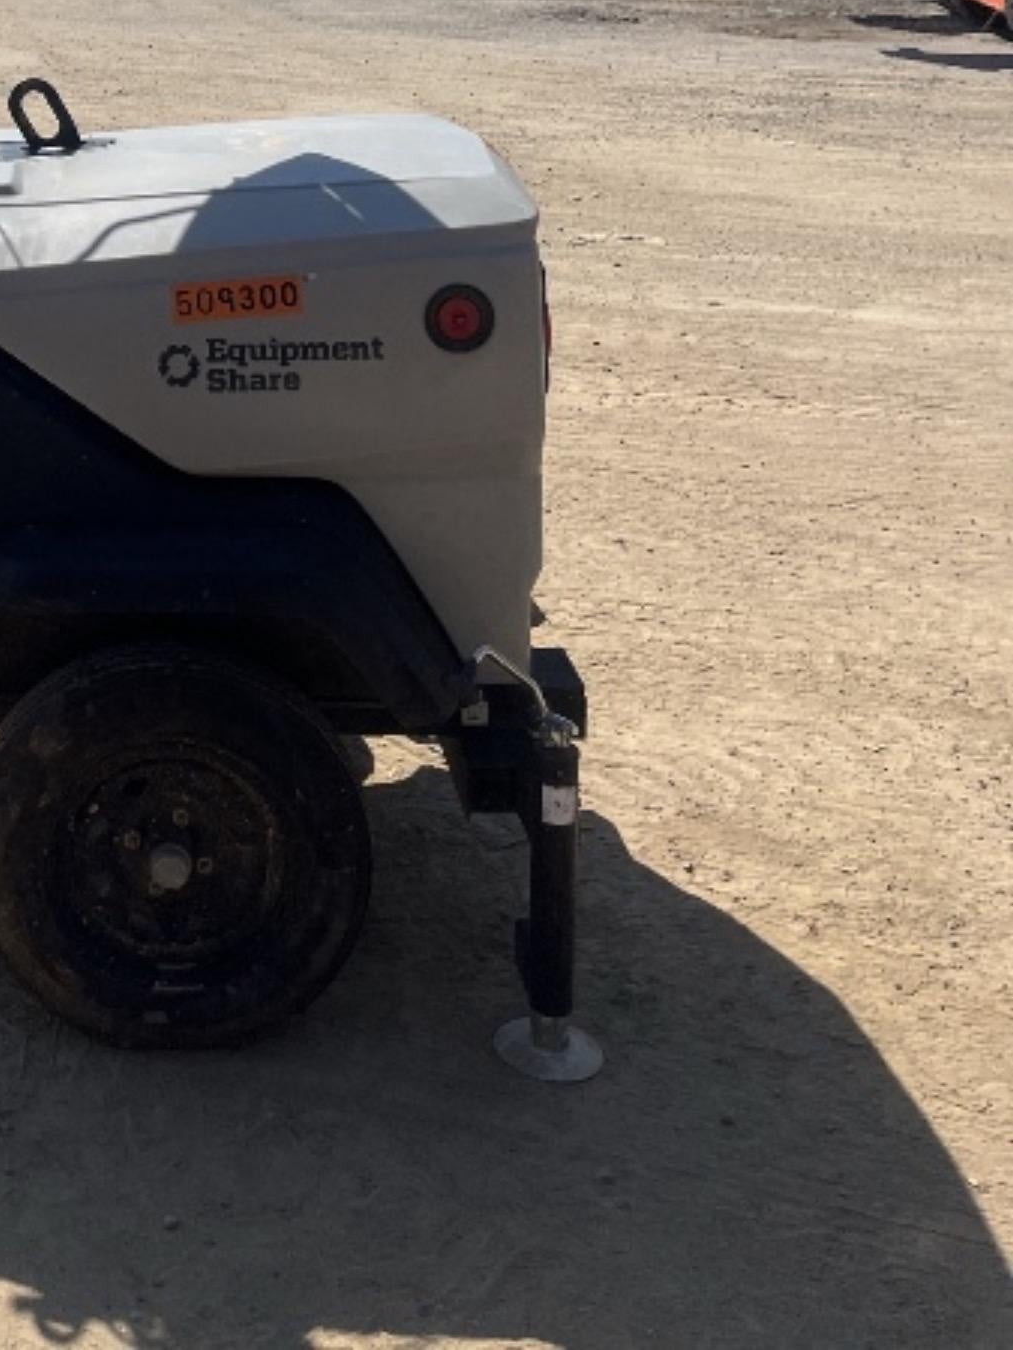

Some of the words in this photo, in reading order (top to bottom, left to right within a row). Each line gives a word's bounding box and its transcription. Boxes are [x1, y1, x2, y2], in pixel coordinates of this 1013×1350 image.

[175, 280, 299, 317] 509300
[205, 335, 385, 367] Equipment
[205, 367, 301, 394] Share
